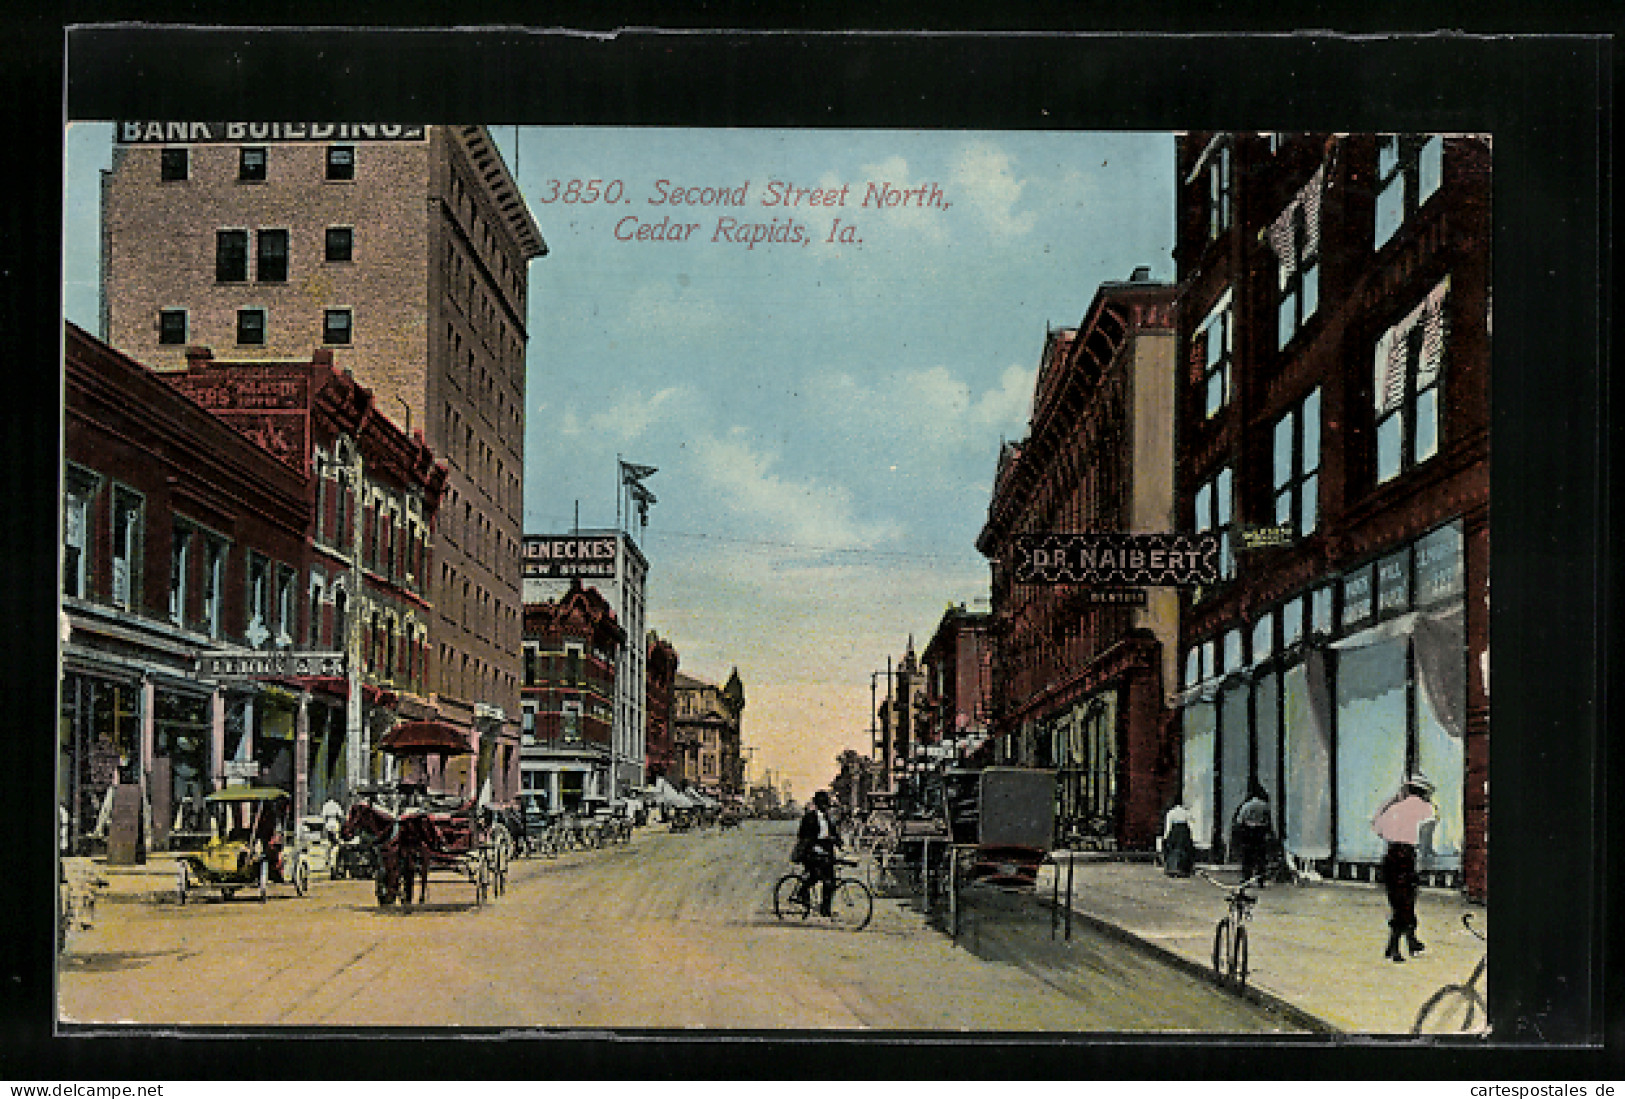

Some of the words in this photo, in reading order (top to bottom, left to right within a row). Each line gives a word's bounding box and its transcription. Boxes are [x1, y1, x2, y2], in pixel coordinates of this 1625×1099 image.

[122, 122, 212, 141] BANK
[1033, 549, 1074, 569] DR.
[1080, 549, 1201, 569] NAIBERT
